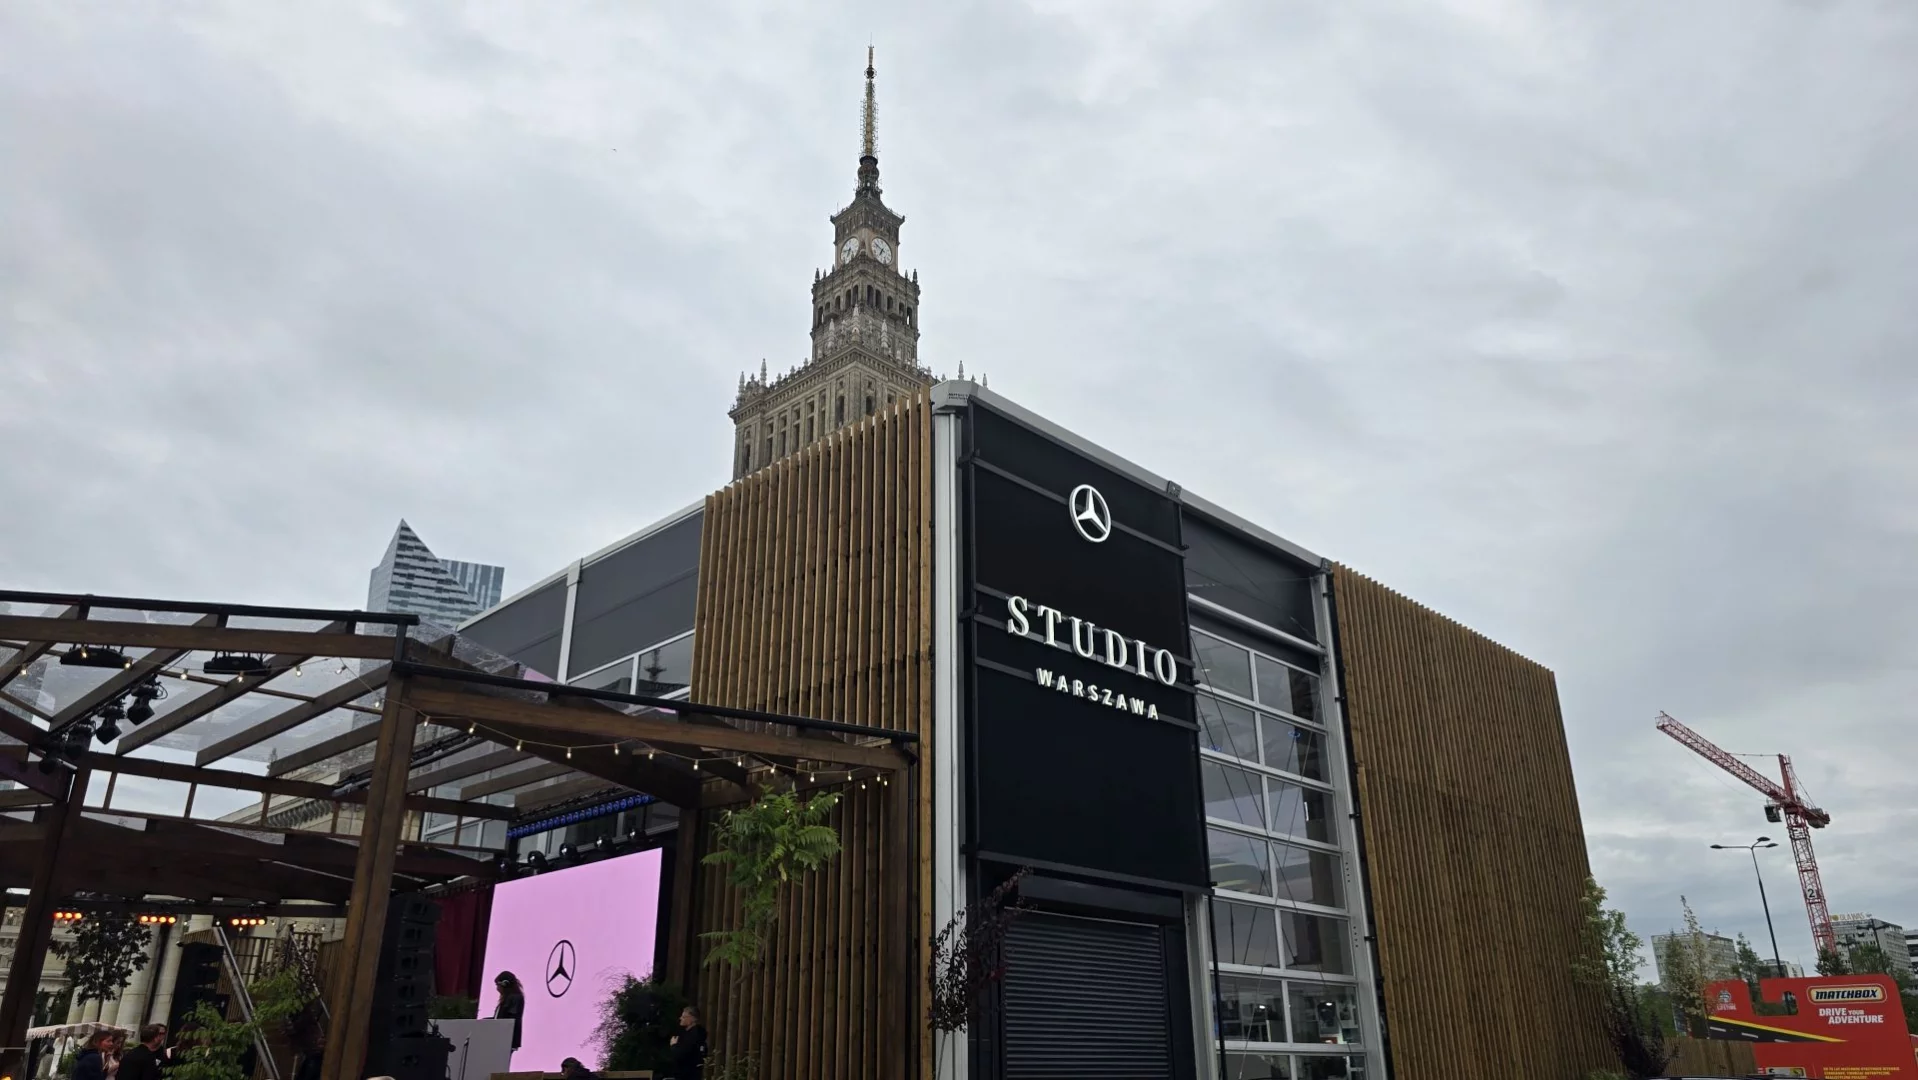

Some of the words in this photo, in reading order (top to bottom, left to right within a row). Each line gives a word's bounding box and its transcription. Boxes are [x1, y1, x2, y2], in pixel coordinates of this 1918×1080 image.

[1007, 595, 1177, 686] STUDIO
[1035, 667, 1159, 720] WARSZAWA
[1807, 888, 1815, 898] 2
[1815, 989, 1878, 1000] MATCHBOX
[1819, 1007, 1847, 1017] DRIVE
[1828, 1015, 1884, 1025] ADVENTURE
